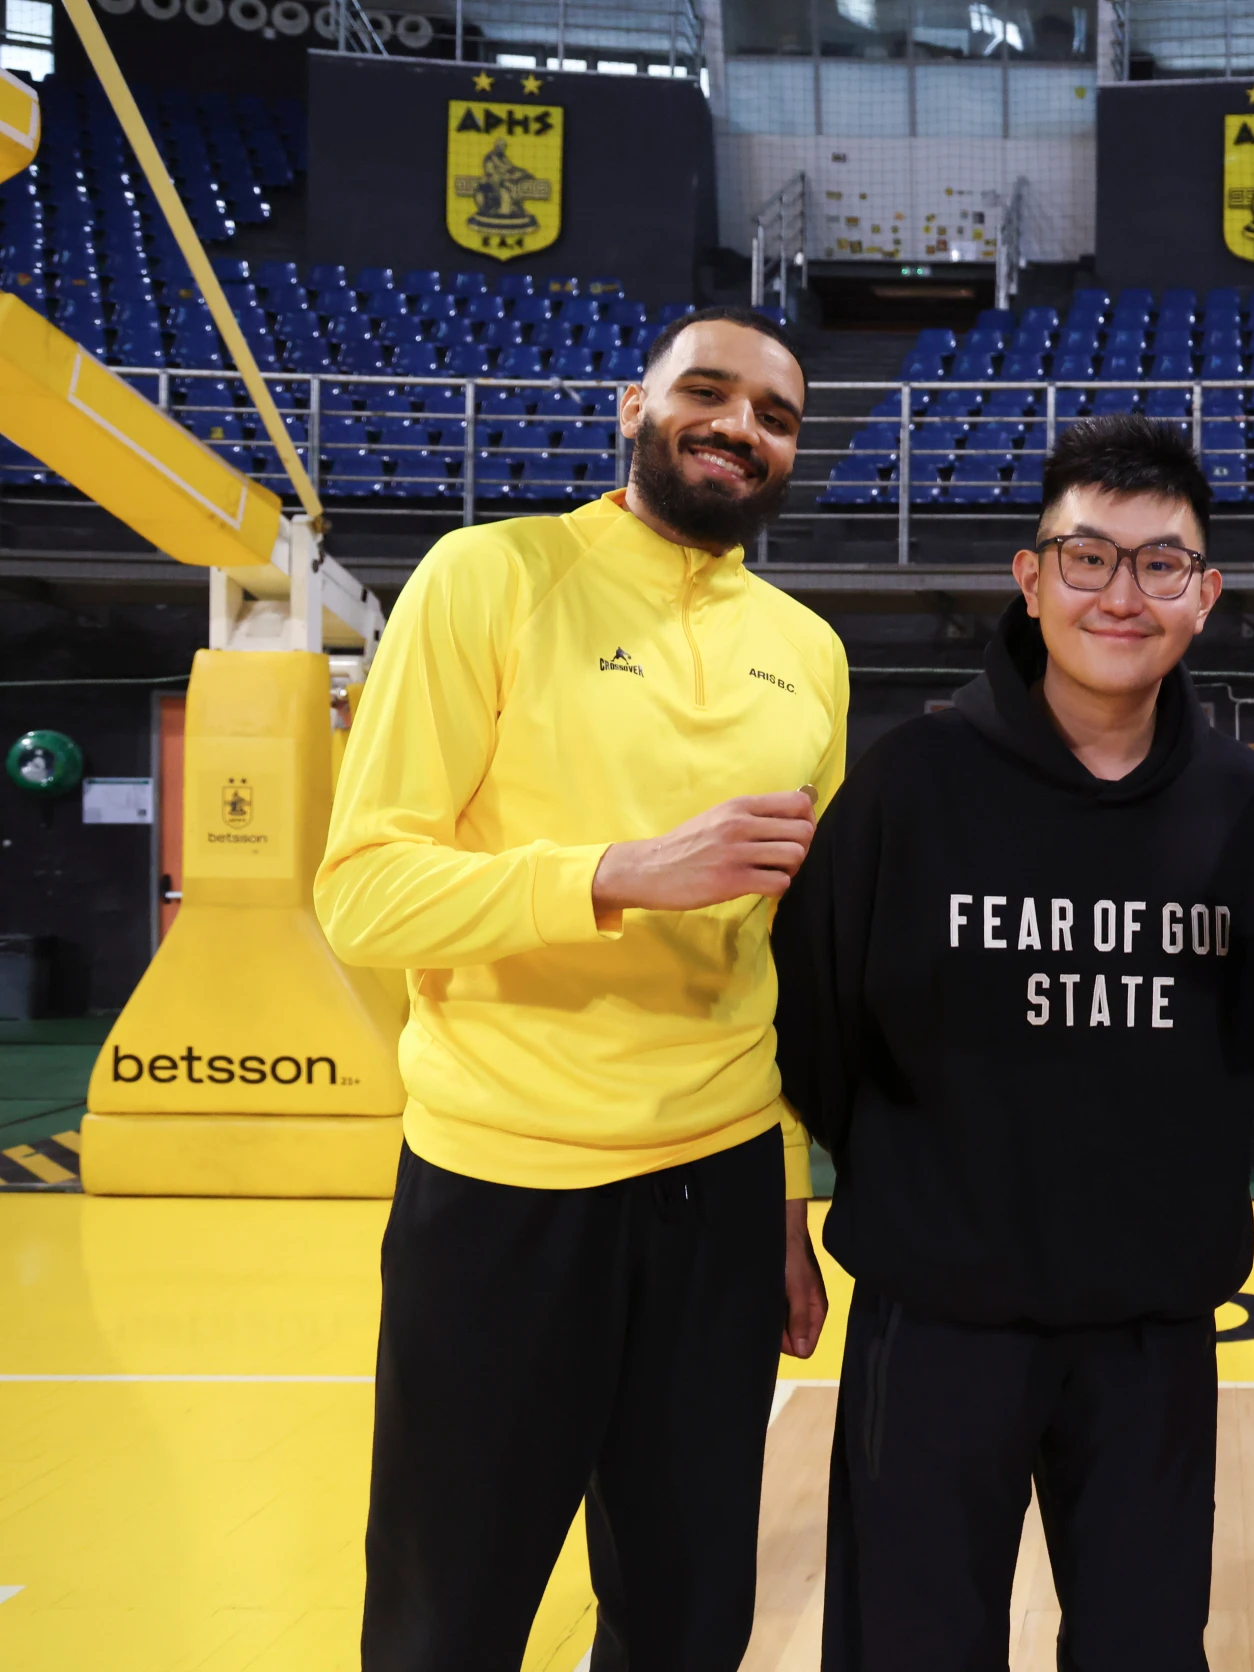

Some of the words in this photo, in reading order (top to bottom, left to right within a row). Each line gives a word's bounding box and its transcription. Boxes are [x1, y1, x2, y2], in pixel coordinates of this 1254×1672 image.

[599, 657, 645, 678] CROSSOVER
[749, 667, 776, 685] ARIS
[777, 678, 797, 695] B.C.
[950, 893, 1074, 951] FEAR
[1093, 899, 1147, 953] OF
[1162, 902, 1231, 956] GOD
[1026, 972, 1175, 1028] STATE
[112, 1045, 337, 1085] betsson
